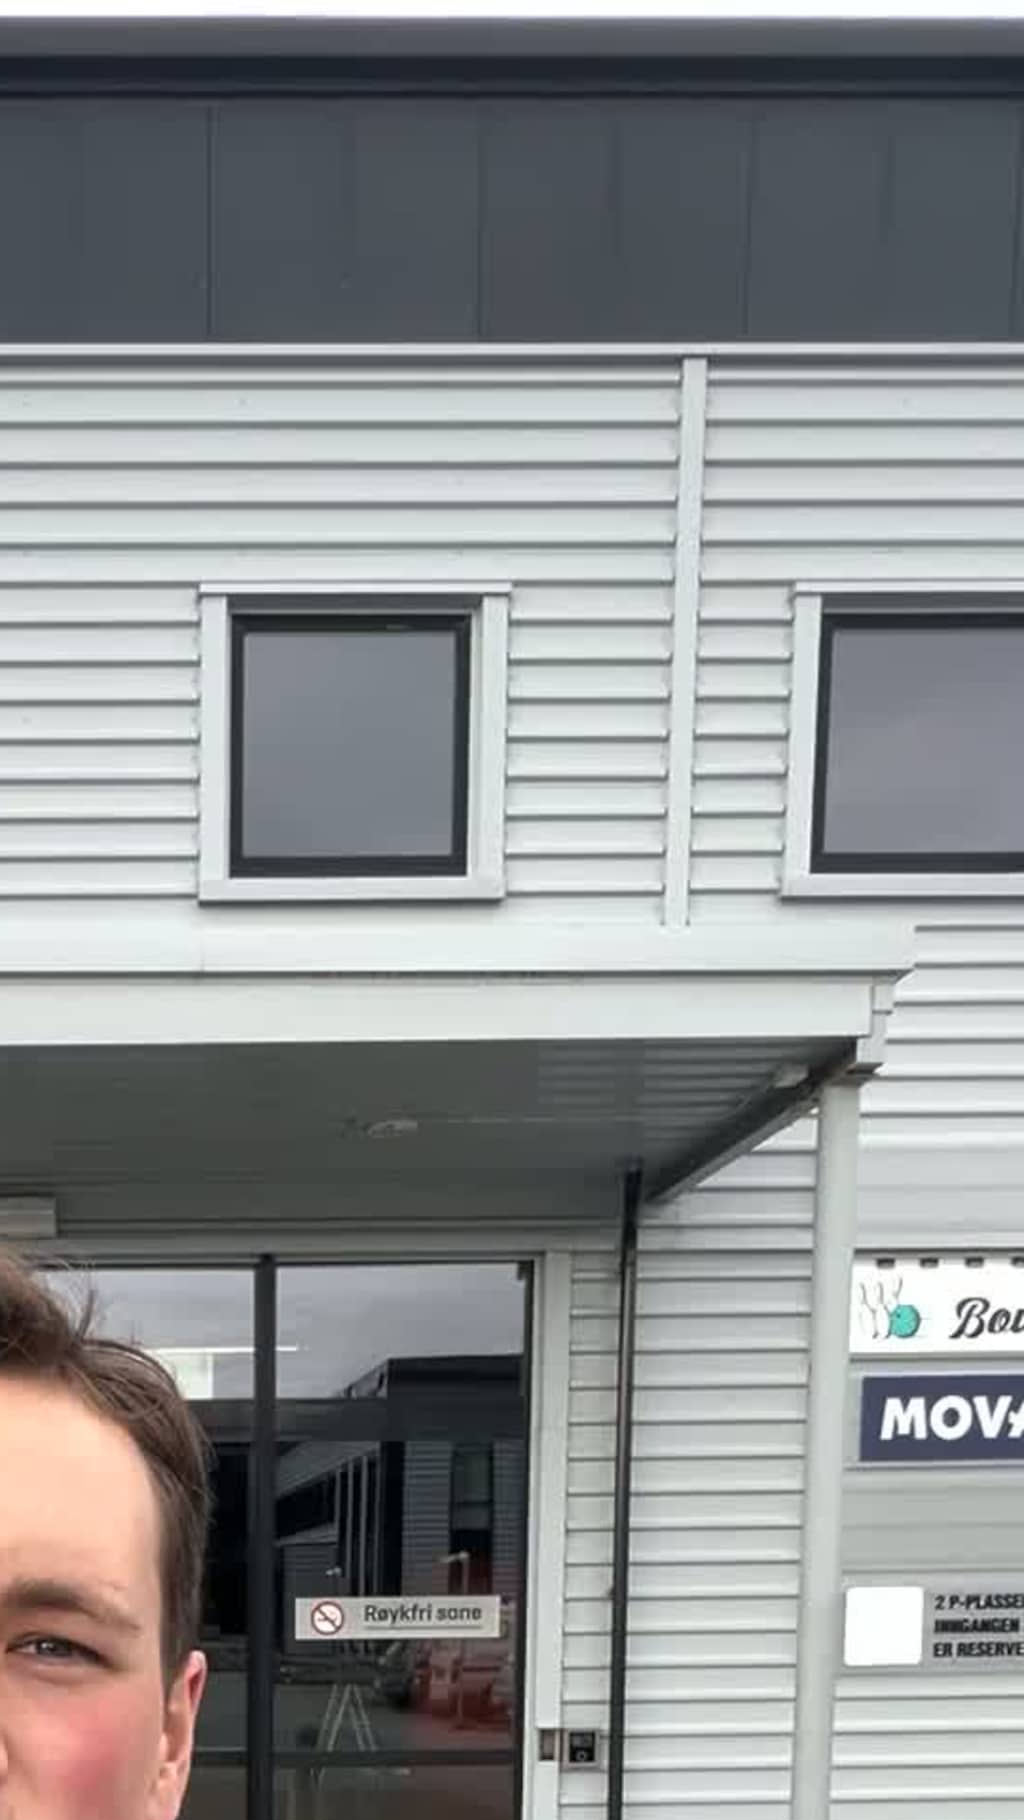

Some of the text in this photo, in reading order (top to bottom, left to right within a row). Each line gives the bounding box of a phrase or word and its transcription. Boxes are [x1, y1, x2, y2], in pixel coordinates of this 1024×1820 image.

[935, 1594, 945, 1610] 2
[364, 1604, 482, 1624] Røykfri sone
[934, 1618, 1019, 1633] INNGANGEN
[934, 1642, 952, 1657] ER
